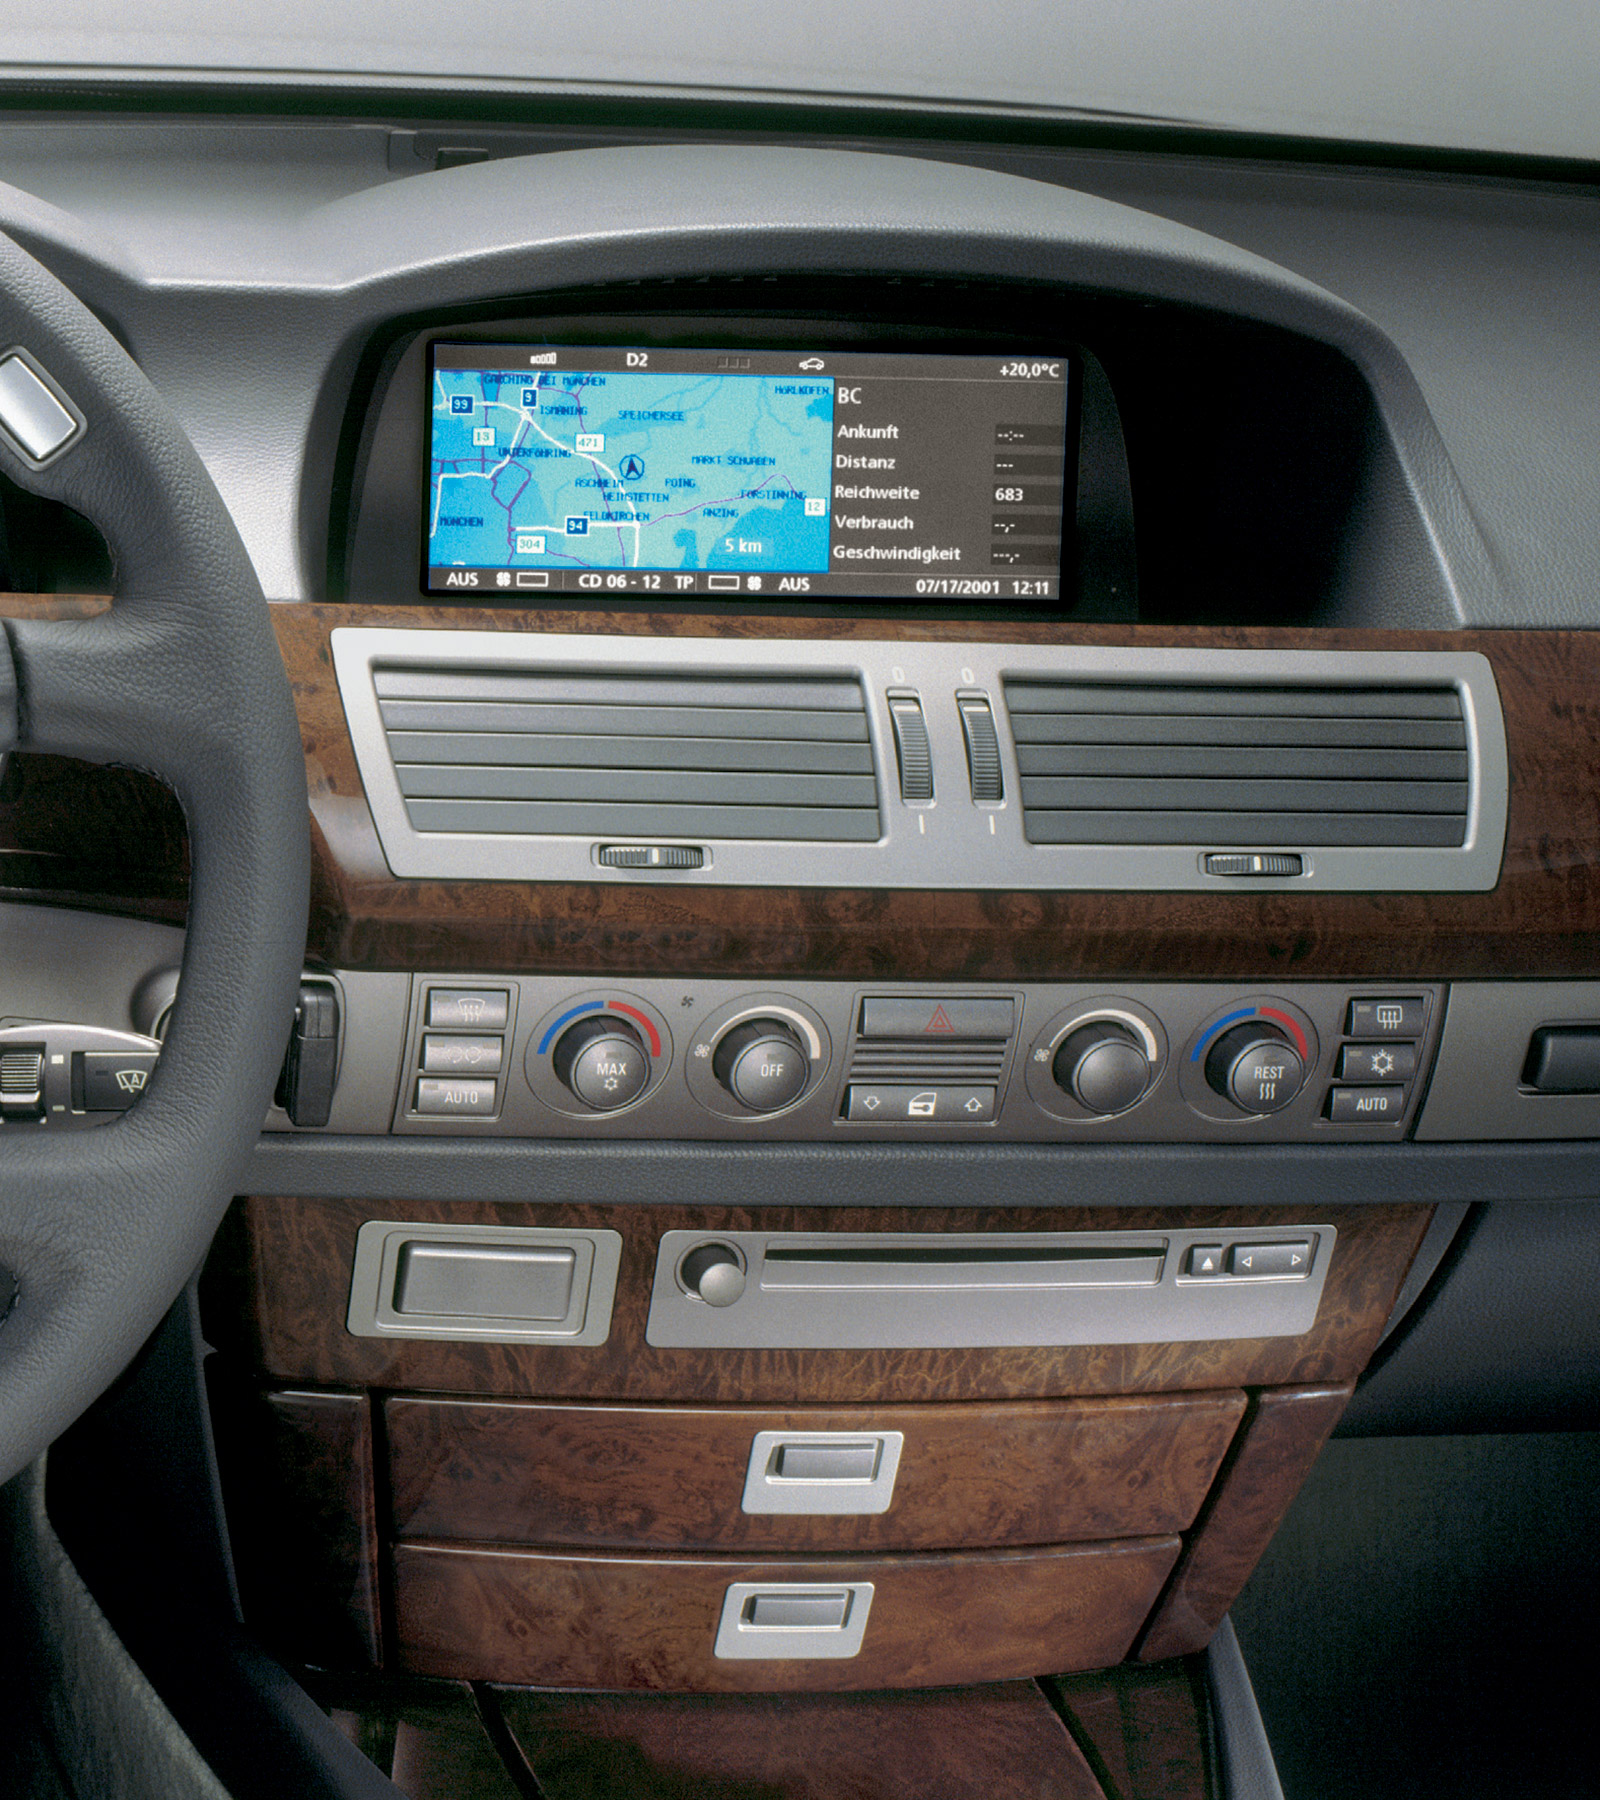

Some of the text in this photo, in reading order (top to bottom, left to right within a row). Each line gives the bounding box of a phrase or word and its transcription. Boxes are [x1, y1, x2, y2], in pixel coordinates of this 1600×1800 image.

[626, 353, 648, 367] D2
[837, 387, 862, 404] BC
[453, 399, 469, 410] 99
[837, 424, 899, 440] Ankunft
[578, 437, 598, 448] 471
[836, 455, 896, 470] Distanz
[835, 485, 1024, 502] Reichweite 683
[568, 520, 583, 531] 94
[835, 515, 914, 530] Verbrauch
[519, 538, 541, 549] 304
[725, 537, 762, 553] 5 km
[833, 545, 961, 564] Geschwindigkeit
[446, 572, 479, 586] AUS
[578, 574, 602, 588] CD
[606, 574, 627, 589] 06
[643, 576, 661, 589] 12
[675, 576, 694, 589] TP
[779, 577, 810, 592] AUS
[915, 579, 1050, 596] 07/17/2001 12:11
[596, 1062, 627, 1076] MAX
[760, 1063, 784, 1077] OFF
[1254, 1066, 1285, 1080] REST
[444, 1091, 478, 1105] AUTO
[1356, 1098, 1388, 1112] AUTO
